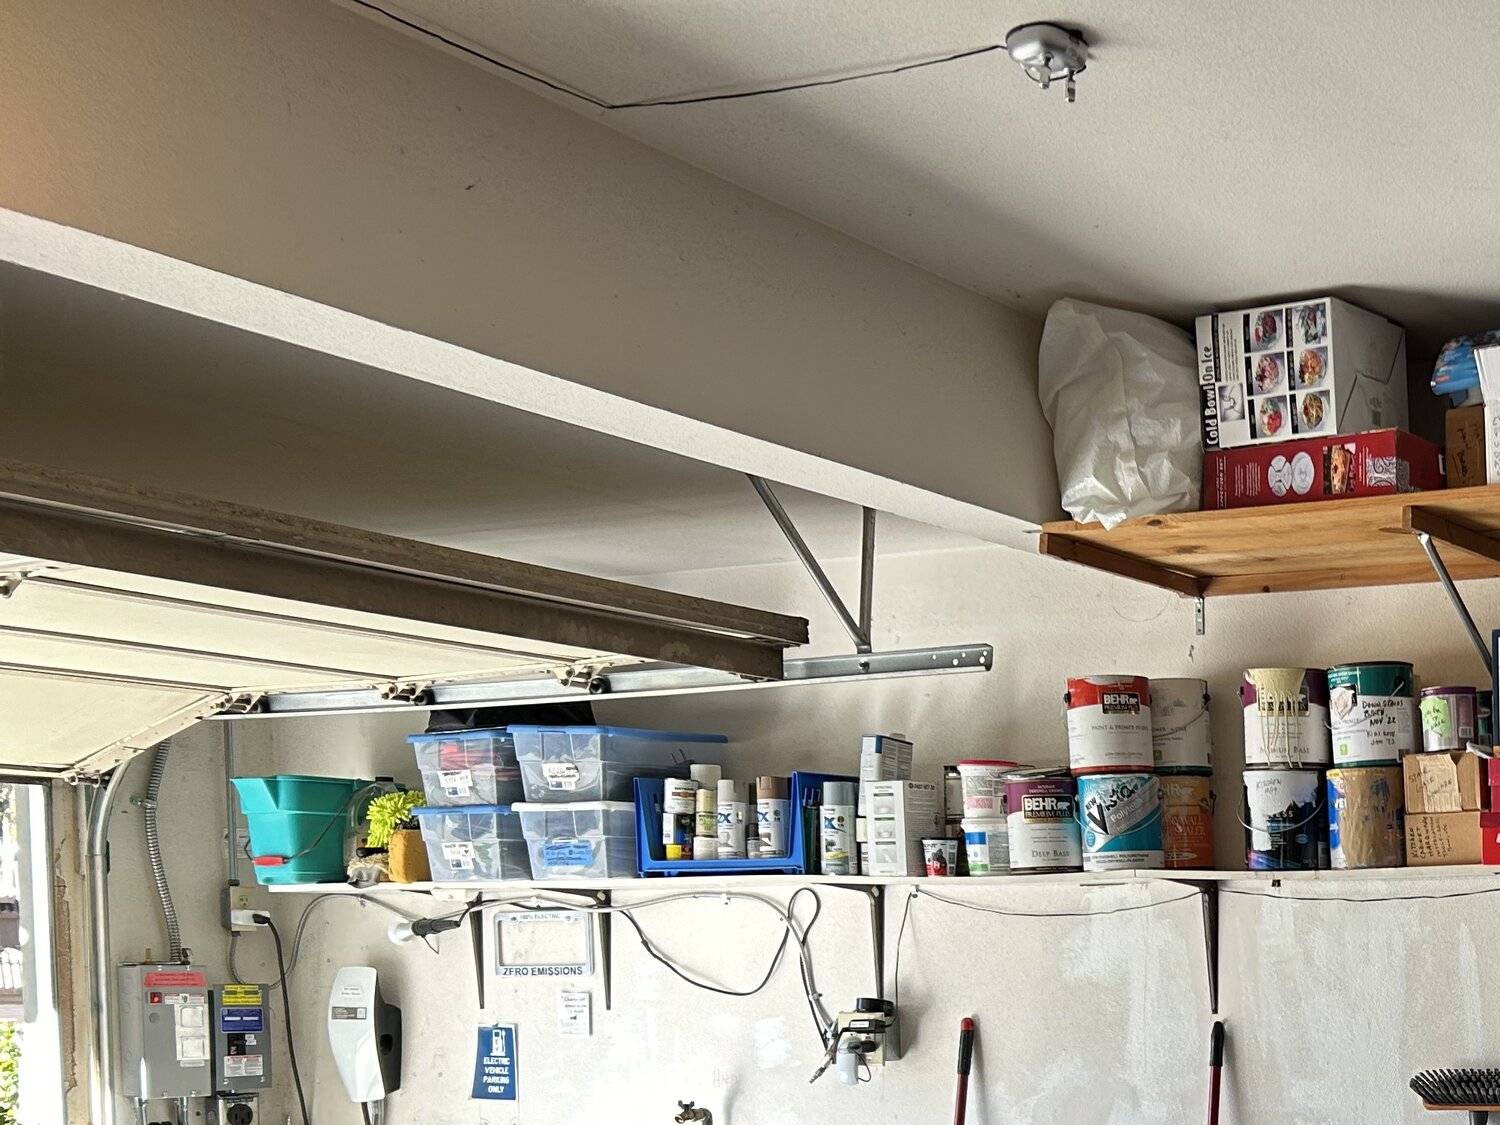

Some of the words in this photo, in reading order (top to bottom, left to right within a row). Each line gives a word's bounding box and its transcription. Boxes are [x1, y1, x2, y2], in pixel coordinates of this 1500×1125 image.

[1201, 346, 1213, 364] Ice
[1202, 365, 1214, 382] On
[1203, 385, 1217, 417] Bowl
[1205, 418, 1219, 445] Cold
[1103, 693, 1129, 705] BEHR
[1024, 797, 1057, 811] BEHR
[502, 967, 529, 976] ZERO
[531, 966, 583, 976] EMISSIONS
[483, 1057, 511, 1065] ELECTRIC
[484, 1066, 509, 1075] VEHICLE
[483, 1076, 510, 1084] PARKING
[487, 1085, 504, 1093] ONLY
